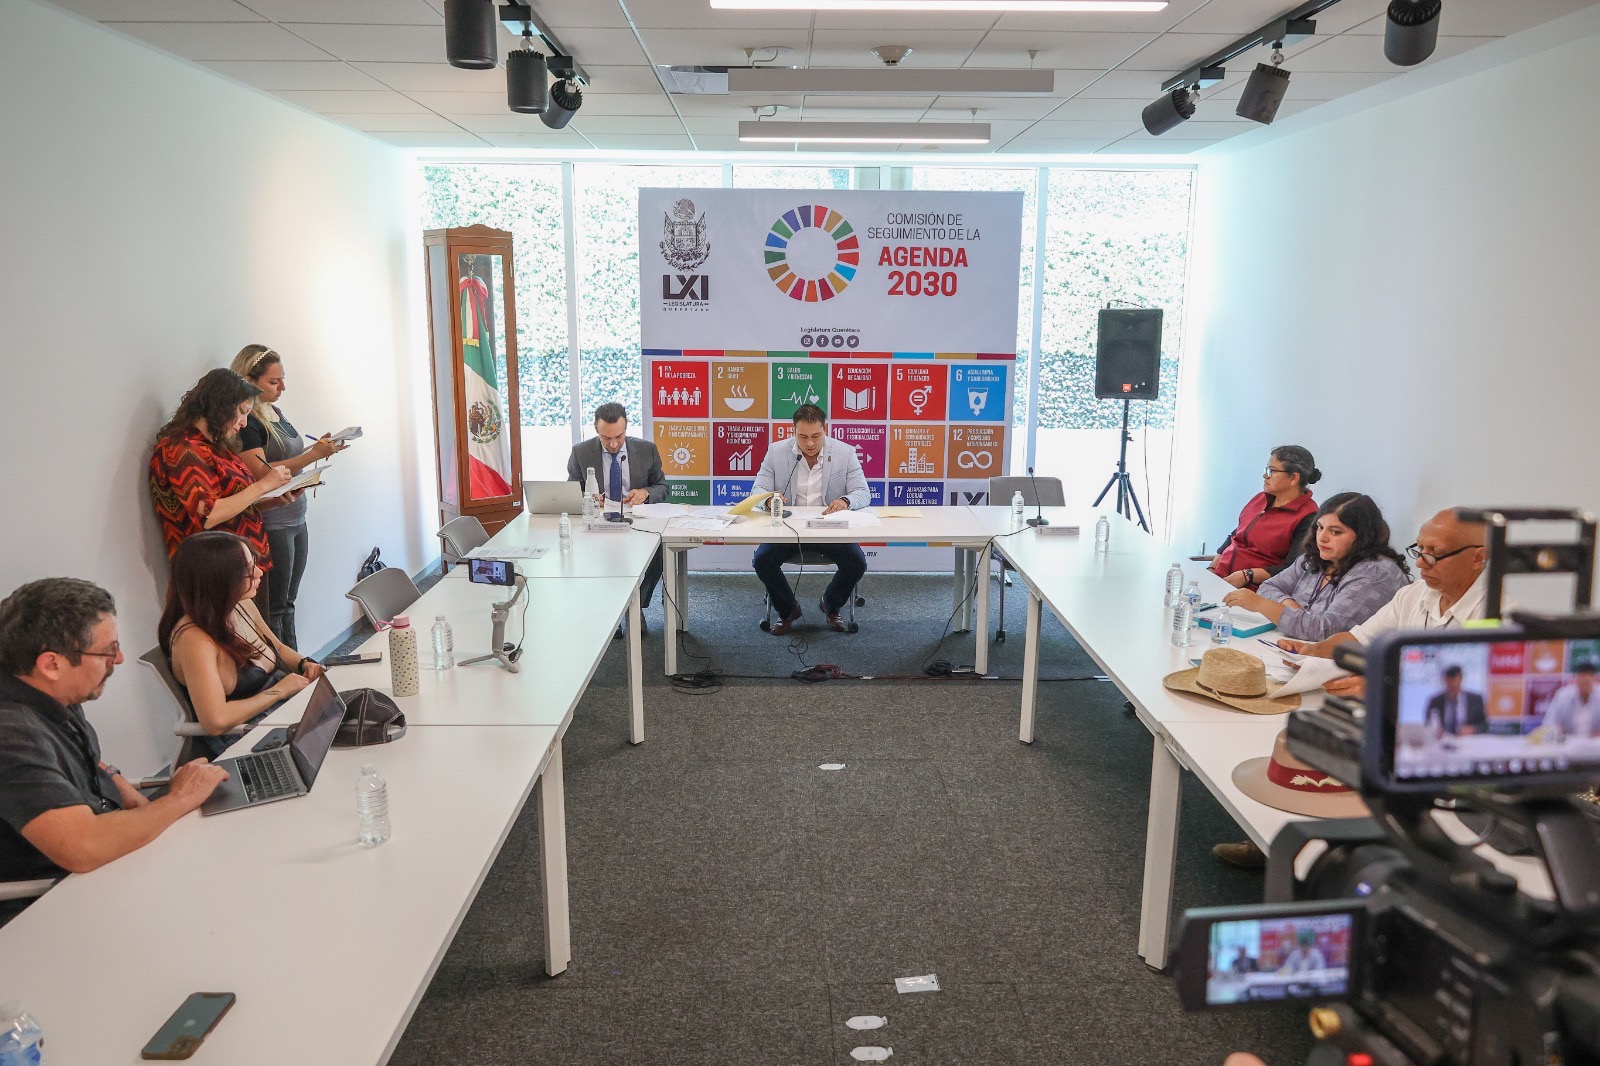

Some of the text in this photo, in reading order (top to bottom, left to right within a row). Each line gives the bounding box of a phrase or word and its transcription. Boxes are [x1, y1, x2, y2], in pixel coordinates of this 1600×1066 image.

[887, 212, 962, 226] COMISIÓN DE
[868, 228, 980, 240] SEGUIMIENTO DE LA
[878, 246, 968, 267] AGENDA
[663, 275, 708, 300] LXI
[888, 271, 957, 296] 2030
[658, 366, 662, 378] 1
[717, 366, 724, 378] 2
[778, 367, 784, 379] 3
[836, 368, 844, 380] 4
[896, 369, 903, 380] 5
[956, 369, 962, 381] 6
[659, 425, 664, 438] 7
[718, 426, 724, 438] 8
[778, 426, 784, 438] 9
[833, 428, 844, 440] 10
[894, 428, 902, 440] 11
[953, 429, 963, 440] 12
[717, 484, 727, 496] 14
[894, 486, 903, 498] 17
